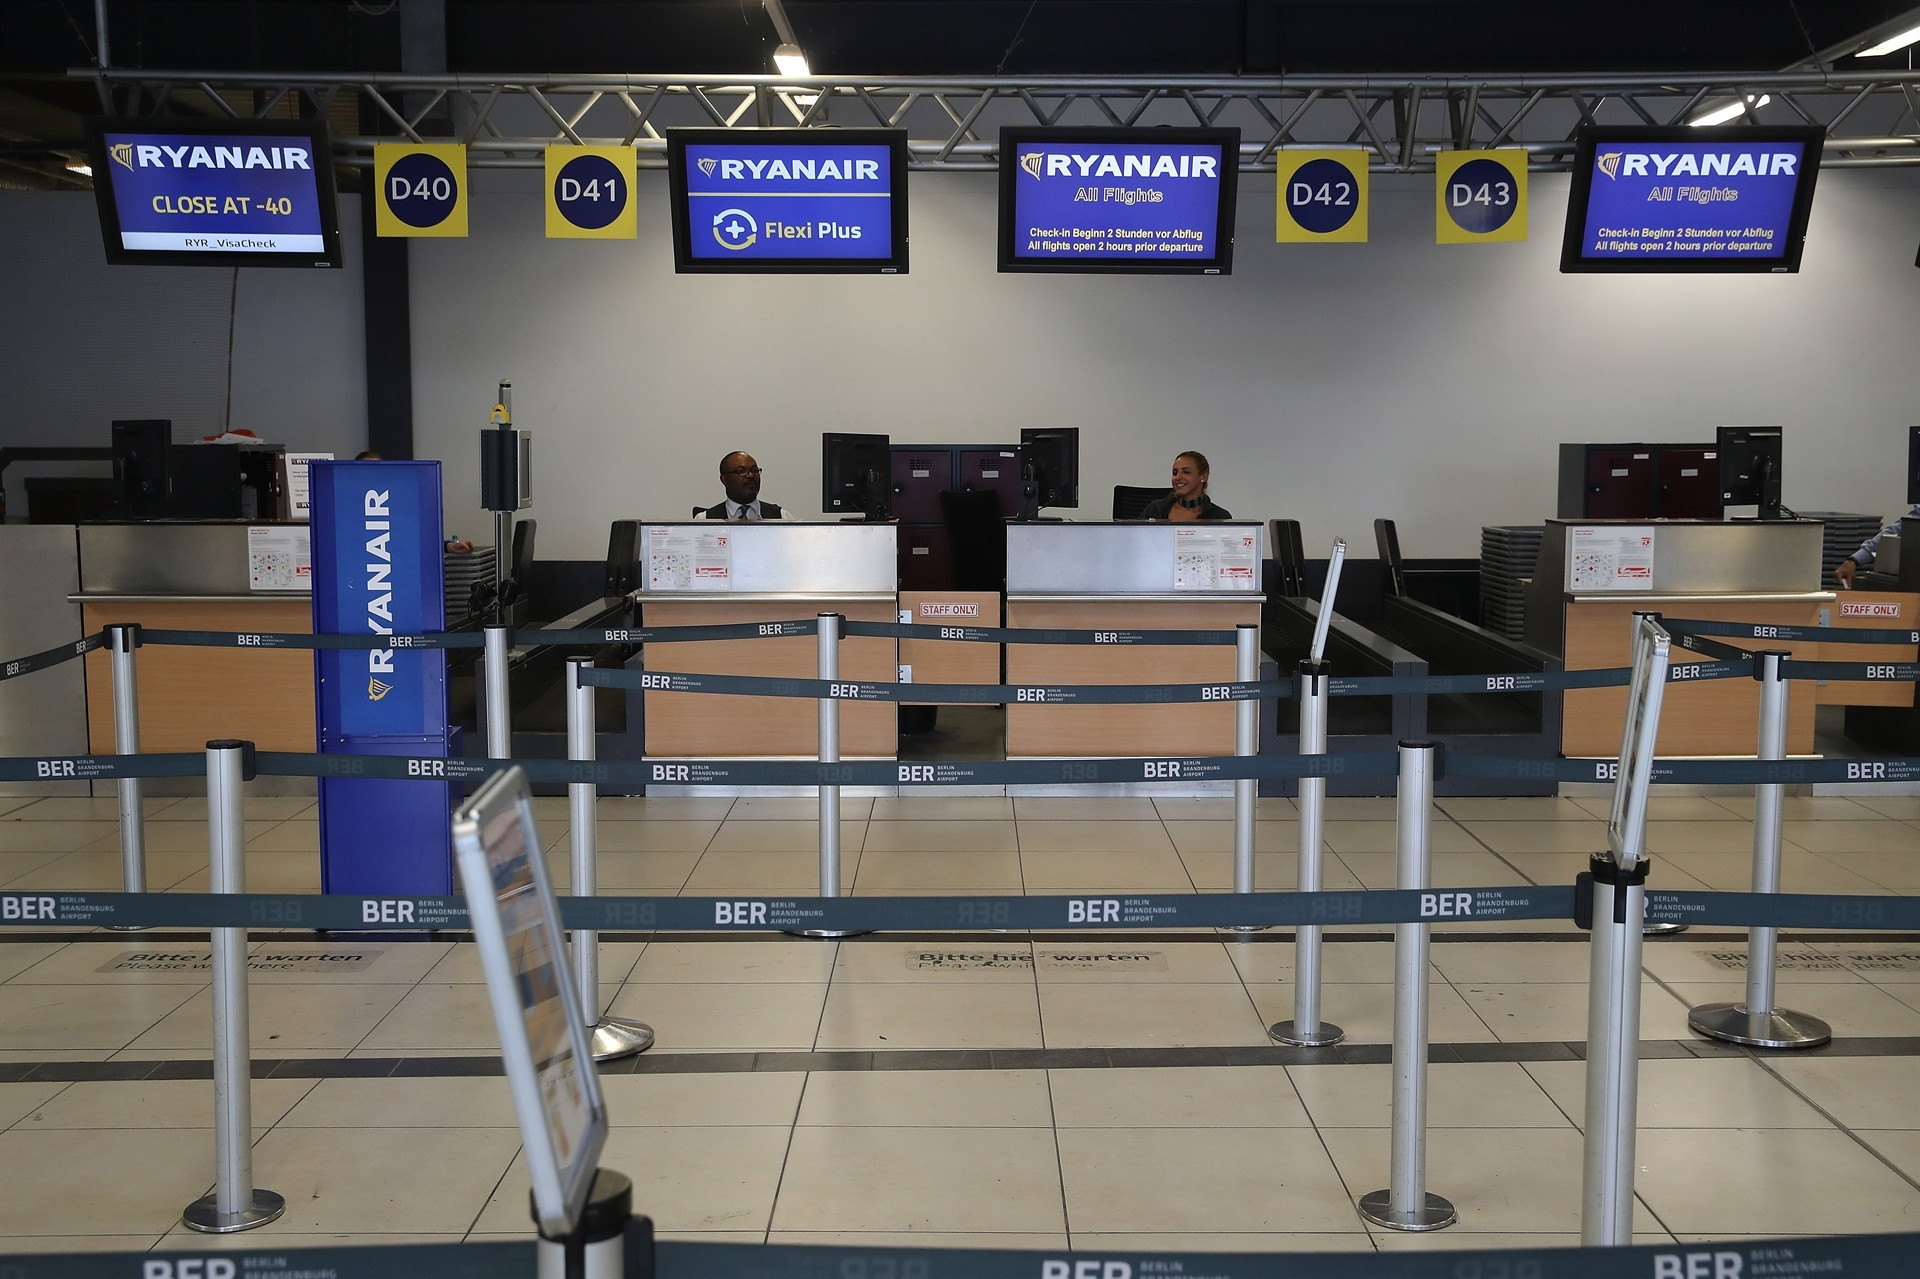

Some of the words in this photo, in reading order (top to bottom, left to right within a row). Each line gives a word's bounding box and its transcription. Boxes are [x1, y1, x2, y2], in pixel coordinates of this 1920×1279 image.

[137, 145, 311, 170] RYANAIR
[1622, 153, 1798, 176] RYANAIR
[721, 159, 879, 180] RYANAIR
[1047, 154, 1217, 178] RYANAIR
[391, 177, 451, 201] D40
[561, 178, 616, 202] D41
[1074, 187, 1098, 202] All
[1103, 188, 1164, 205] Flights
[1293, 182, 1351, 206] D42
[1453, 181, 1510, 207] D43
[1647, 187, 1672, 201] All
[1677, 187, 1739, 205] Flights
[152, 195, 219, 214] CLOSE
[223, 197, 250, 214] AT
[256, 197, 292, 215] -40
[765, 221, 812, 239] Flexi
[818, 222, 862, 239] Plus
[1029, 227, 1071, 238] Check-in
[1073, 228, 1105, 240] Beginn
[1108, 229, 1113, 238] 2
[1115, 228, 1153, 239] Stunden
[1156, 231, 1171, 239] vor
[1172, 229, 1203, 241] Abflug
[1598, 228, 1639, 237] Check-in
[1641, 228, 1675, 239] Beginn
[1677, 228, 1683, 237] 2
[1685, 228, 1723, 238] Stunden
[1742, 228, 1774, 239] Abflug
[185, 238, 276, 249] RYR_VisaCheck
[1028, 241, 1040, 250] All
[1043, 241, 1071, 252] flights
[1073, 243, 1096, 252] open
[1098, 242, 1104, 251] 2
[1106, 241, 1133, 251] hours
[1135, 242, 1157, 253] prior
[1159, 242, 1203, 254] departure
[1595, 241, 1608, 250] All
[1609, 241, 1638, 252] flights
[1640, 243, 1664, 252] open
[1666, 241, 1672, 250] 2
[1674, 241, 1700, 250] hours
[1703, 241, 1725, 252] prior
[1727, 241, 1773, 252] departure
[364, 489, 394, 673] RYANAIR
[923, 605, 950, 614] STAFF
[953, 605, 976, 614] ONLY
[1843, 605, 1870, 614] STAFF
[1873, 606, 1897, 615] ONLY
[605, 630, 629, 641] BER
[759, 624, 783, 635] BER
[941, 627, 964, 639] BER
[1753, 626, 1777, 638] BER
[238, 635, 261, 646] BER
[389, 636, 412, 647] BER
[1094, 632, 1118, 643] BER
[1683, 636, 1692, 648] BER
[76, 641, 87, 653] BER
[6, 662, 19, 676] BER
[1672, 665, 1699, 679] BER
[1867, 666, 1895, 679] BER
[641, 674, 670, 689] BER
[1487, 677, 1515, 690] BER
[830, 684, 859, 698] BER
[1017, 688, 1046, 701] BER
[1202, 686, 1230, 700] BER
[37, 760, 76, 777] BER
[408, 760, 444, 776] BER
[652, 765, 689, 781] BER
[898, 765, 934, 781] BER
[1144, 761, 1180, 778] BER
[1596, 763, 1618, 779] BE
[1847, 763, 1885, 779] BER
[2, 896, 56, 919] BER
[1420, 893, 1472, 917] BER
[1477, 899, 1529, 907] BRANDENBURG
[1654, 904, 1705, 912] BRANDENBURG
[362, 900, 414, 923] BER
[715, 901, 766, 925] BER
[1068, 900, 1120, 922] BER
[128, 954, 196, 962] Bitte
[266, 954, 362, 962] warten
[1712, 953, 1782, 961] Bit
[1786, 953, 1839, 961] hier
[115, 962, 183, 970] Please
[1751, 1249, 1793, 1259] BERLIN
[1751, 1260, 1842, 1273] BRANDENBURG
